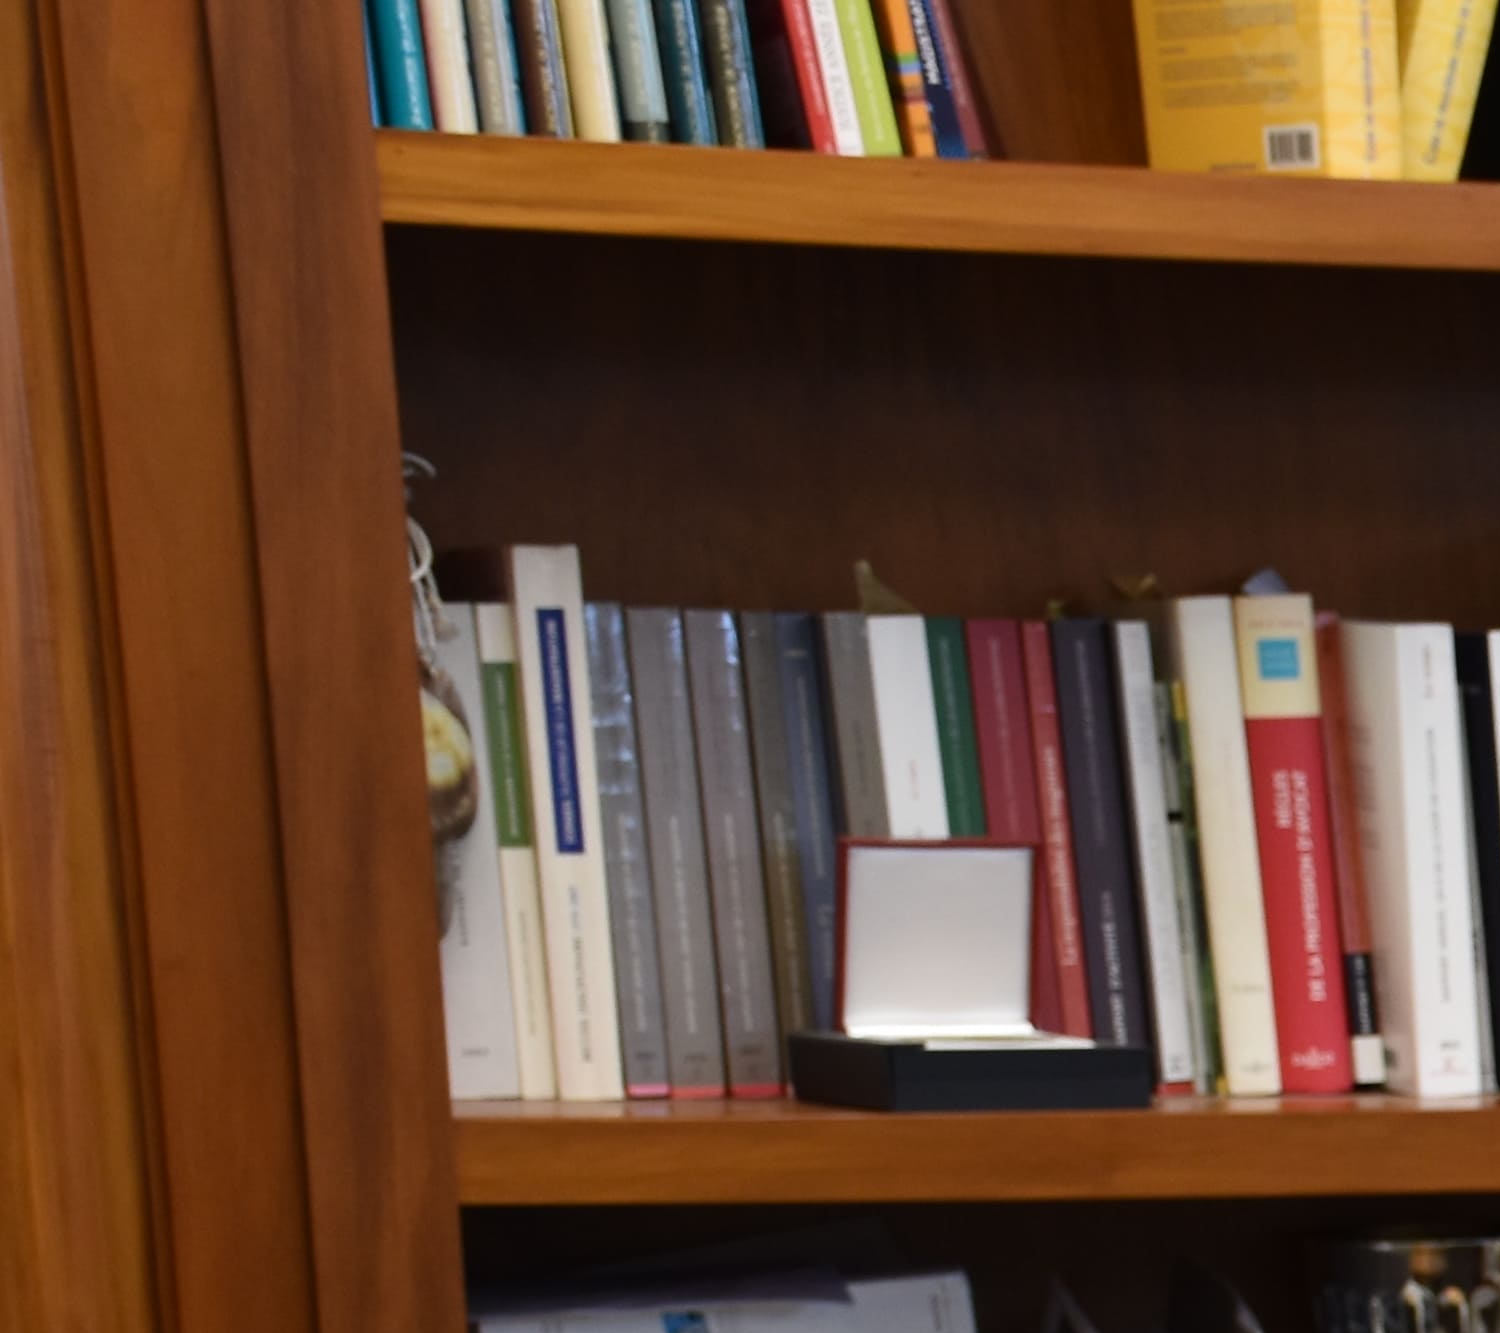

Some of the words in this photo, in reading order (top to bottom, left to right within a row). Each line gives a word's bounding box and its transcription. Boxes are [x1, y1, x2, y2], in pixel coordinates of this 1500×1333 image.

[1299, 853, 1325, 953] PROFESSION
[1306, 949, 1326, 976] LA
[1308, 979, 1328, 1003] DE
